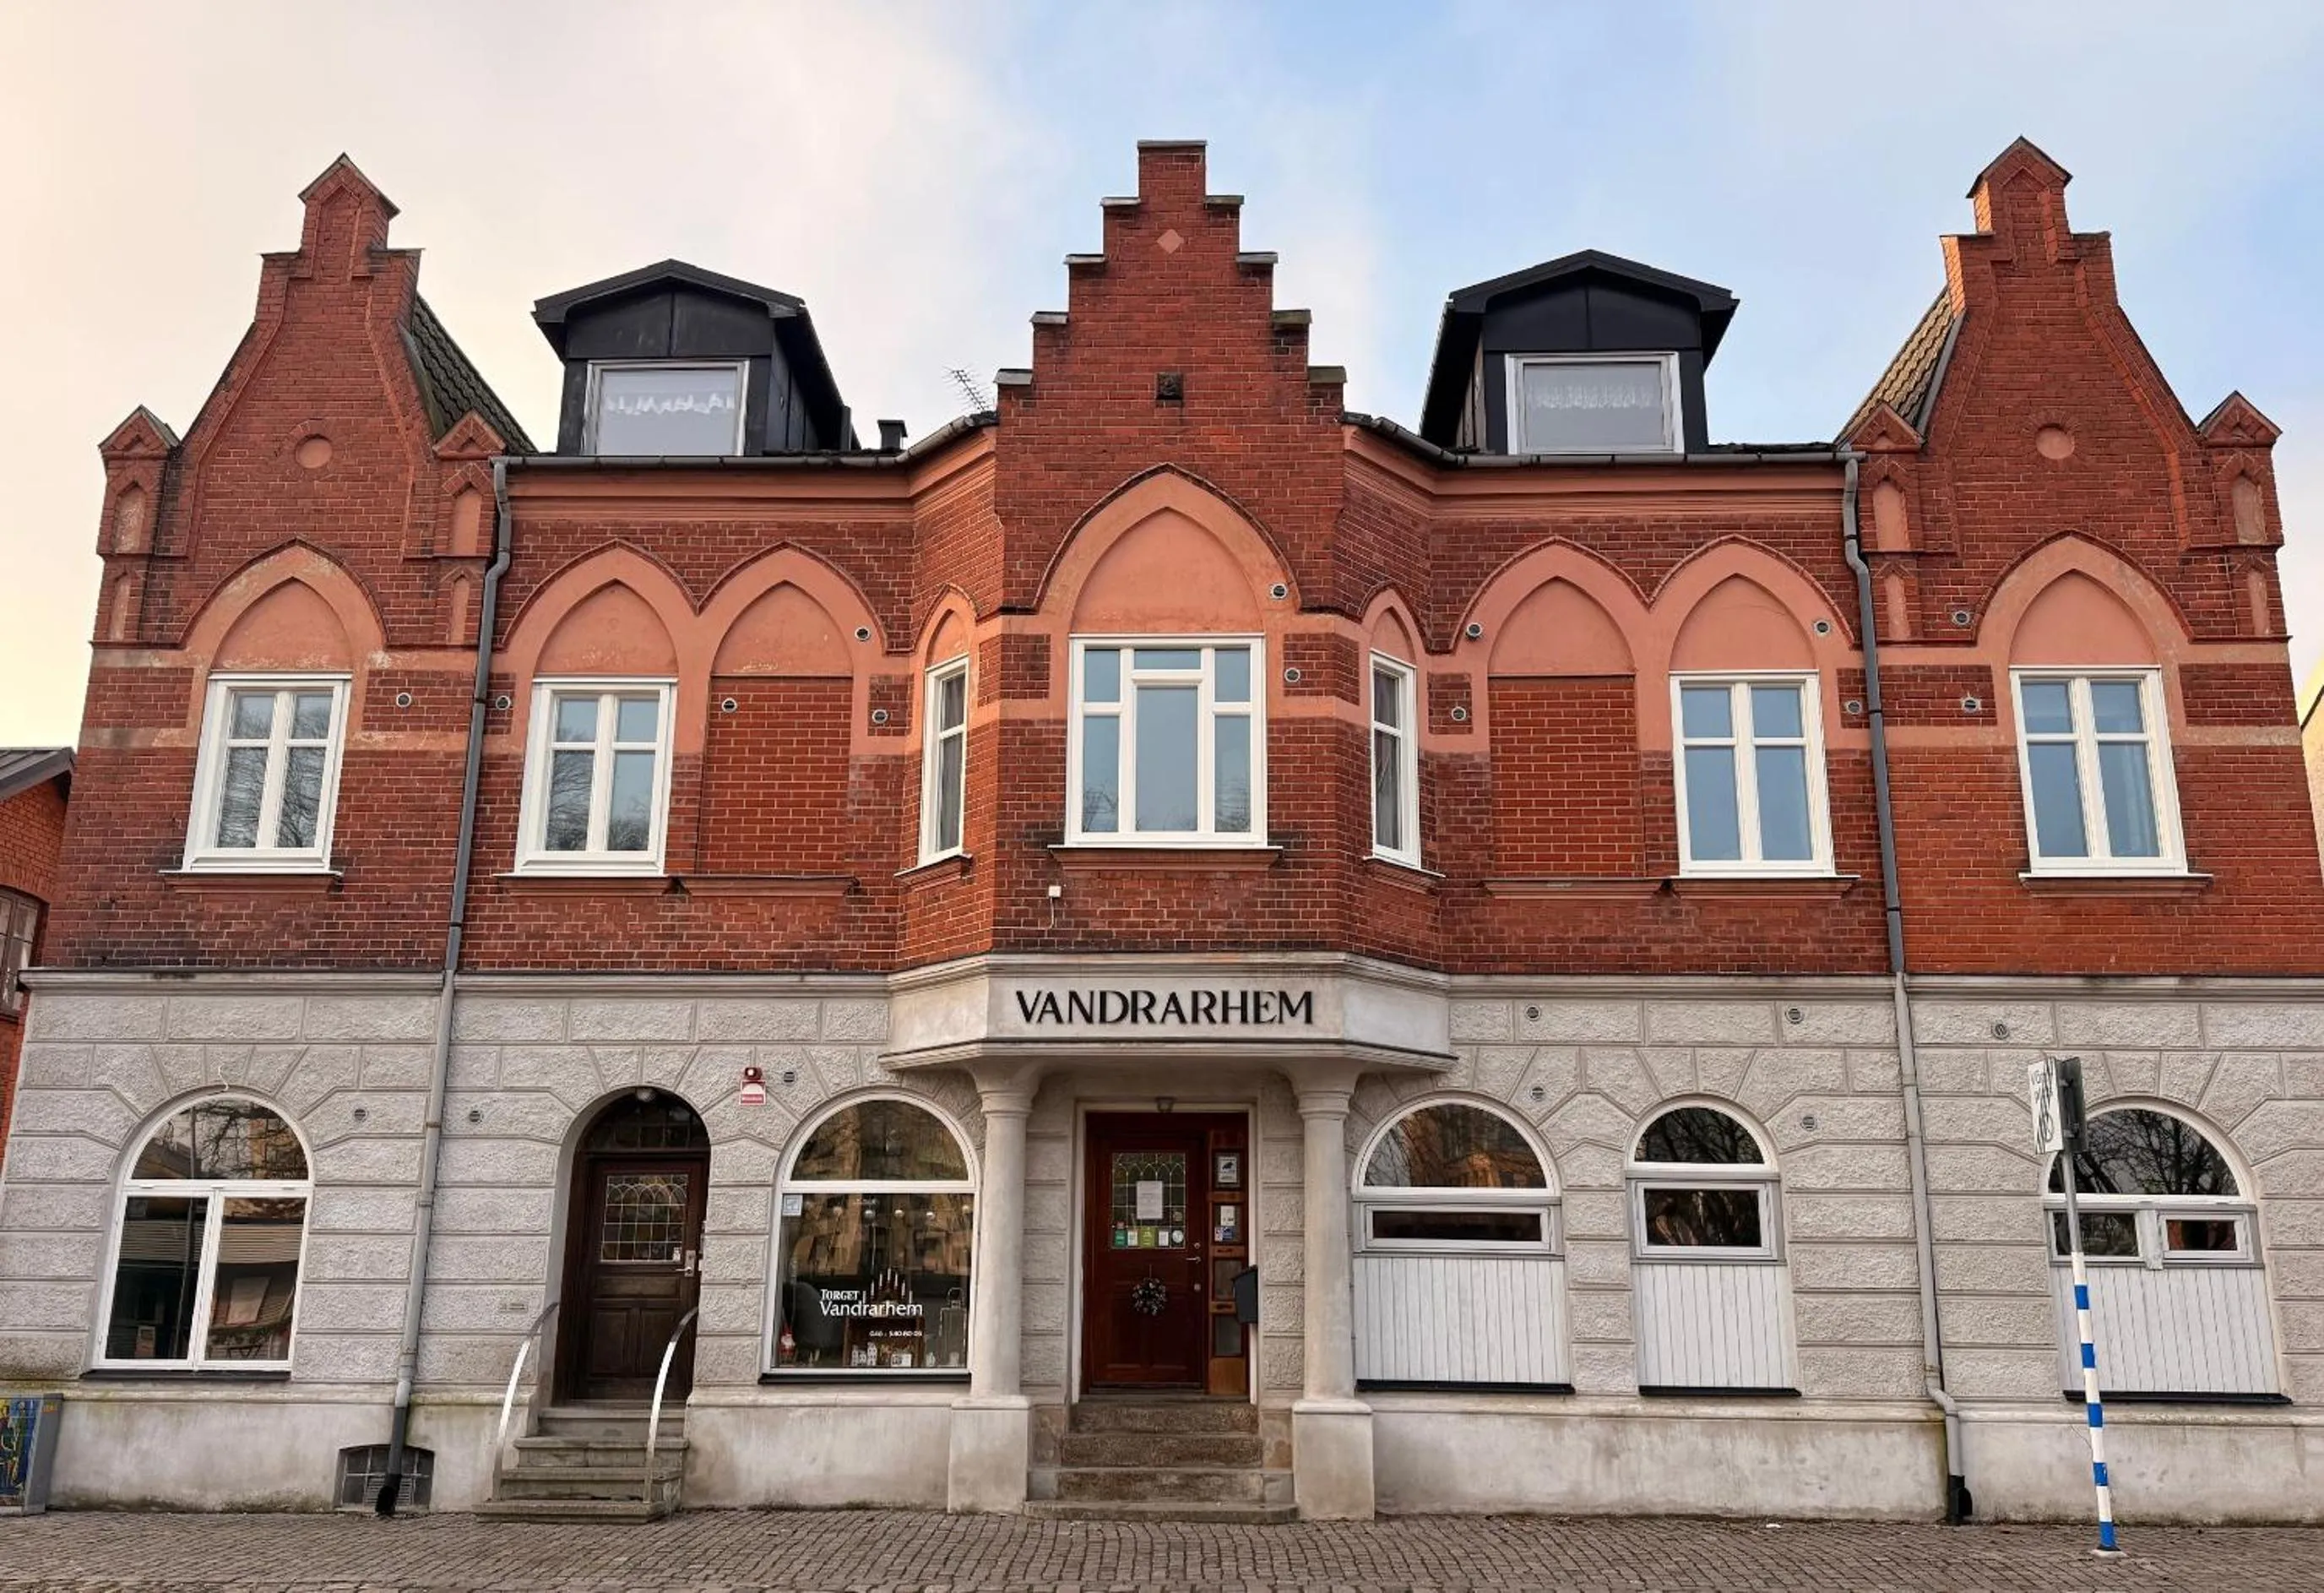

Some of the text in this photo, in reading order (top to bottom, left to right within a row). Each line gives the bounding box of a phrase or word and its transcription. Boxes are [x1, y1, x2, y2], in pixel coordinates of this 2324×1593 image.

[1016, 990, 1313, 1025] VANDRARHEM
[821, 1289, 860, 1301] TORGET
[819, 1301, 923, 1317] Vandrarhem
